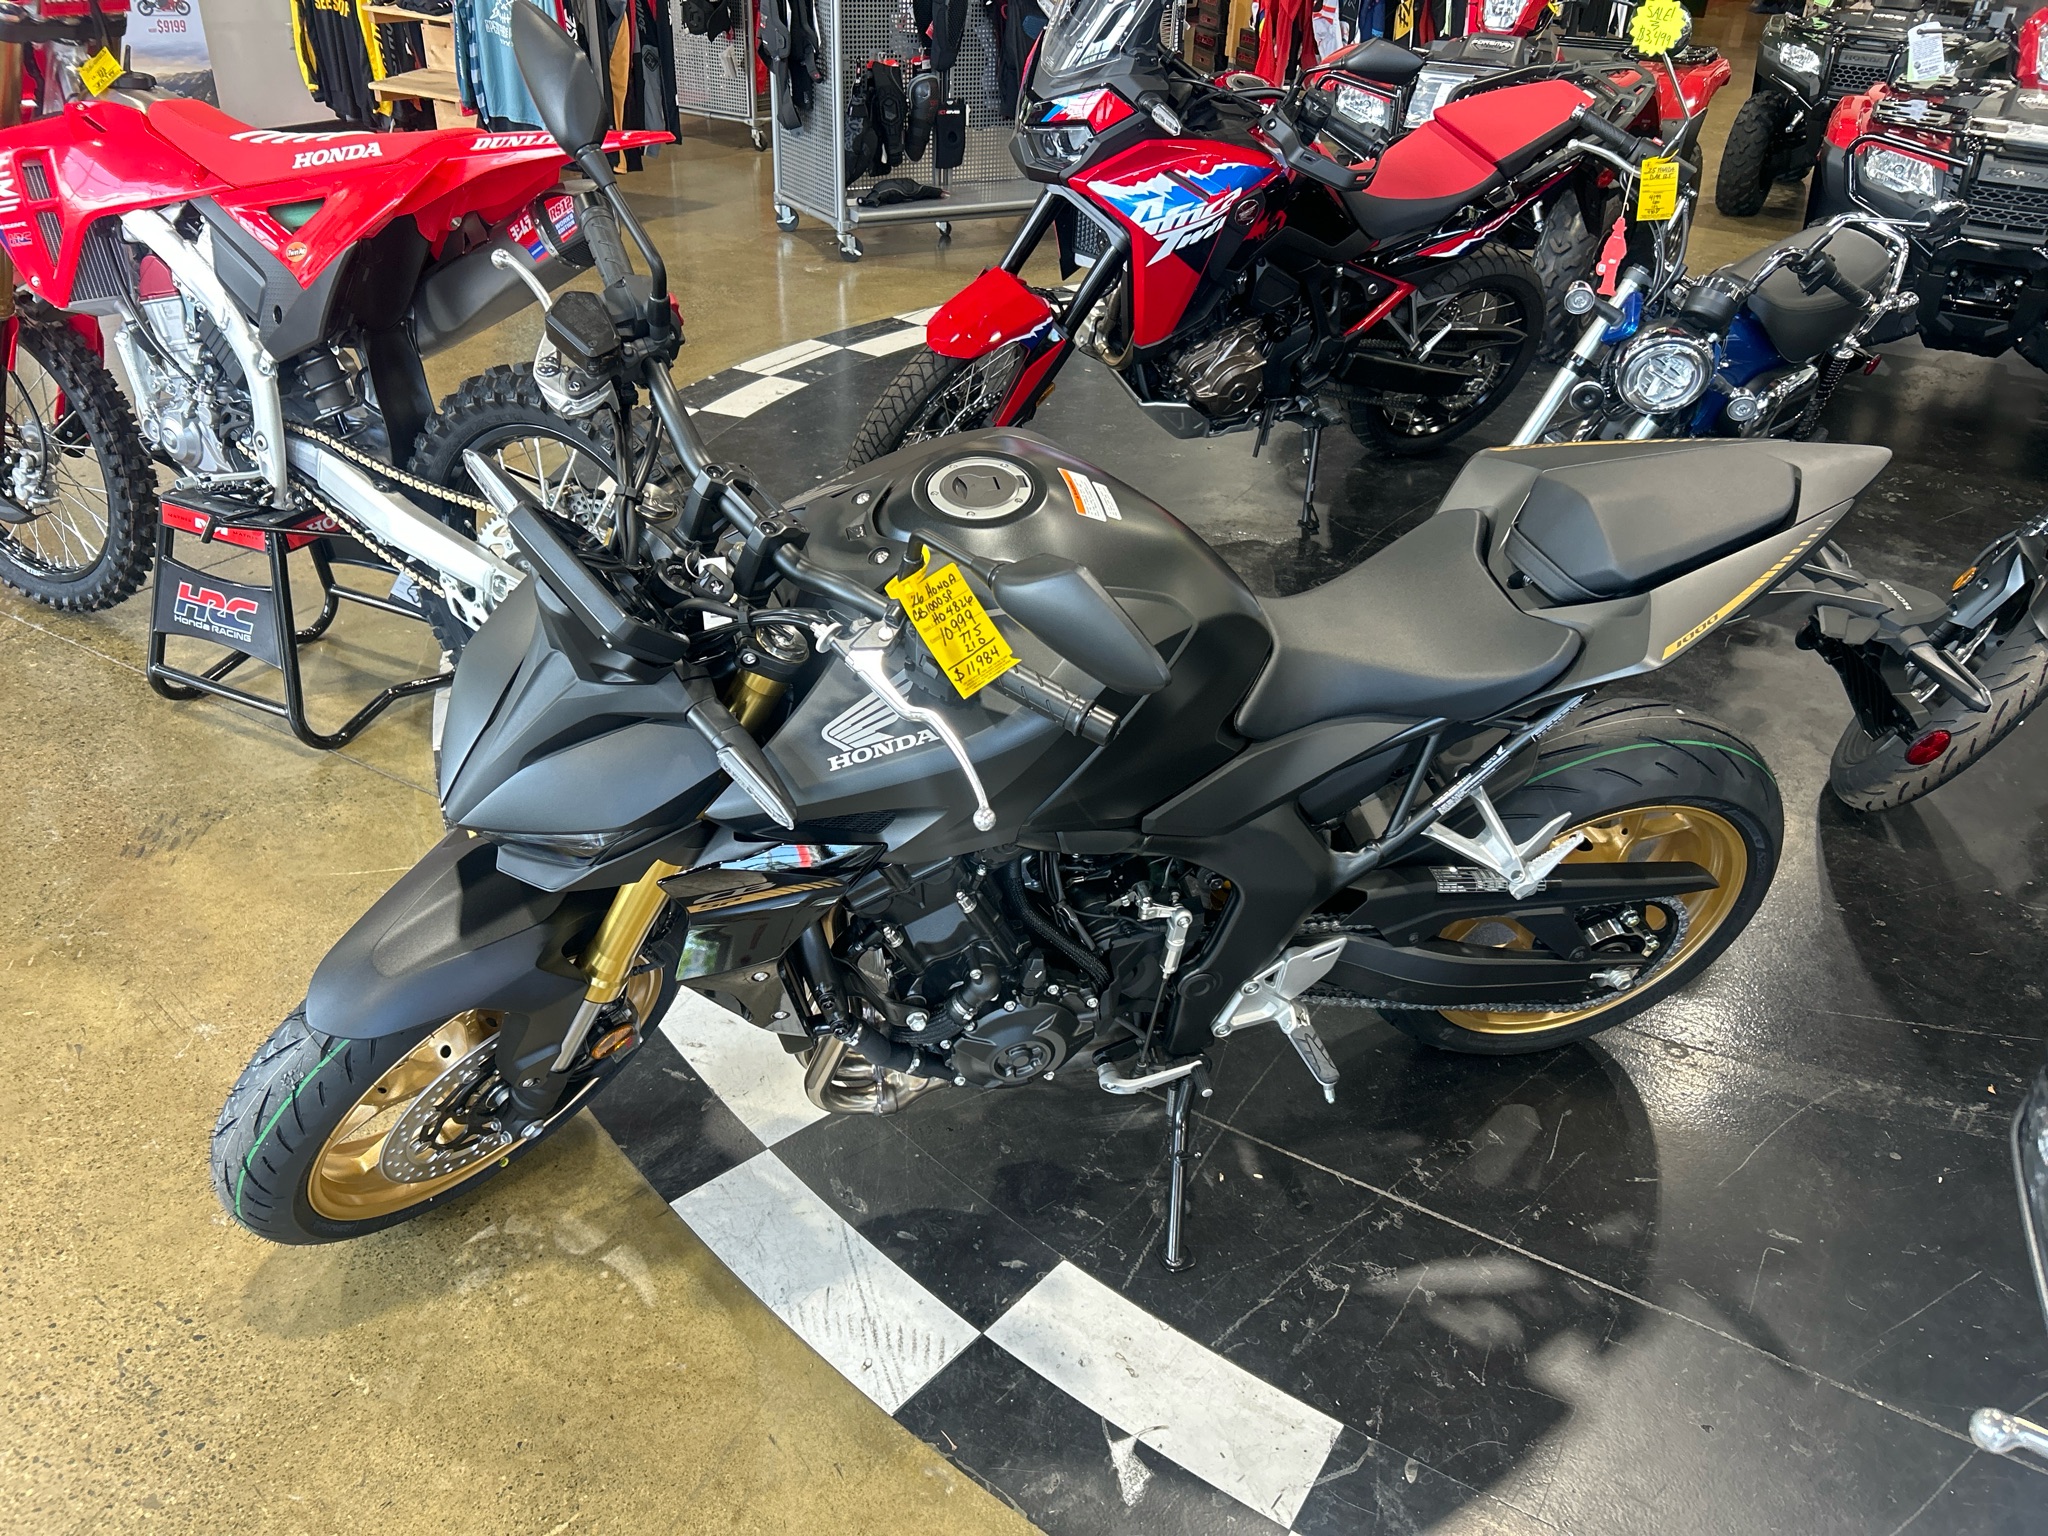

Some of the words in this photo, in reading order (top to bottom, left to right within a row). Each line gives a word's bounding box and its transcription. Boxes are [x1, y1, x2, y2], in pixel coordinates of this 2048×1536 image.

[157, 19, 187, 34] $9199
[1647, 6, 1676, 21] SALE!
[1637, 25, 1671, 46] $3,499
[1844, 54, 1884, 65] HONDA
[292, 141, 383, 170] HONDA
[470, 133, 557, 151] DUNLO
[1129, 187, 1243, 236] Africa
[168, 513, 192, 523] MATRIX
[910, 594, 924, 608] 26
[926, 573, 957, 598] HONDA
[1879, 580, 1912, 611] HONDA
[174, 581, 259, 634] HRC
[174, 615, 210, 631] Honda
[211, 624, 252, 643] RACING
[939, 609, 977, 646] 10999
[959, 622, 983, 644] 775
[1676, 613, 1719, 648] 1000
[965, 637, 987, 653] 210
[954, 645, 1000, 683] $11,984
[827, 728, 940, 772] HONDA
